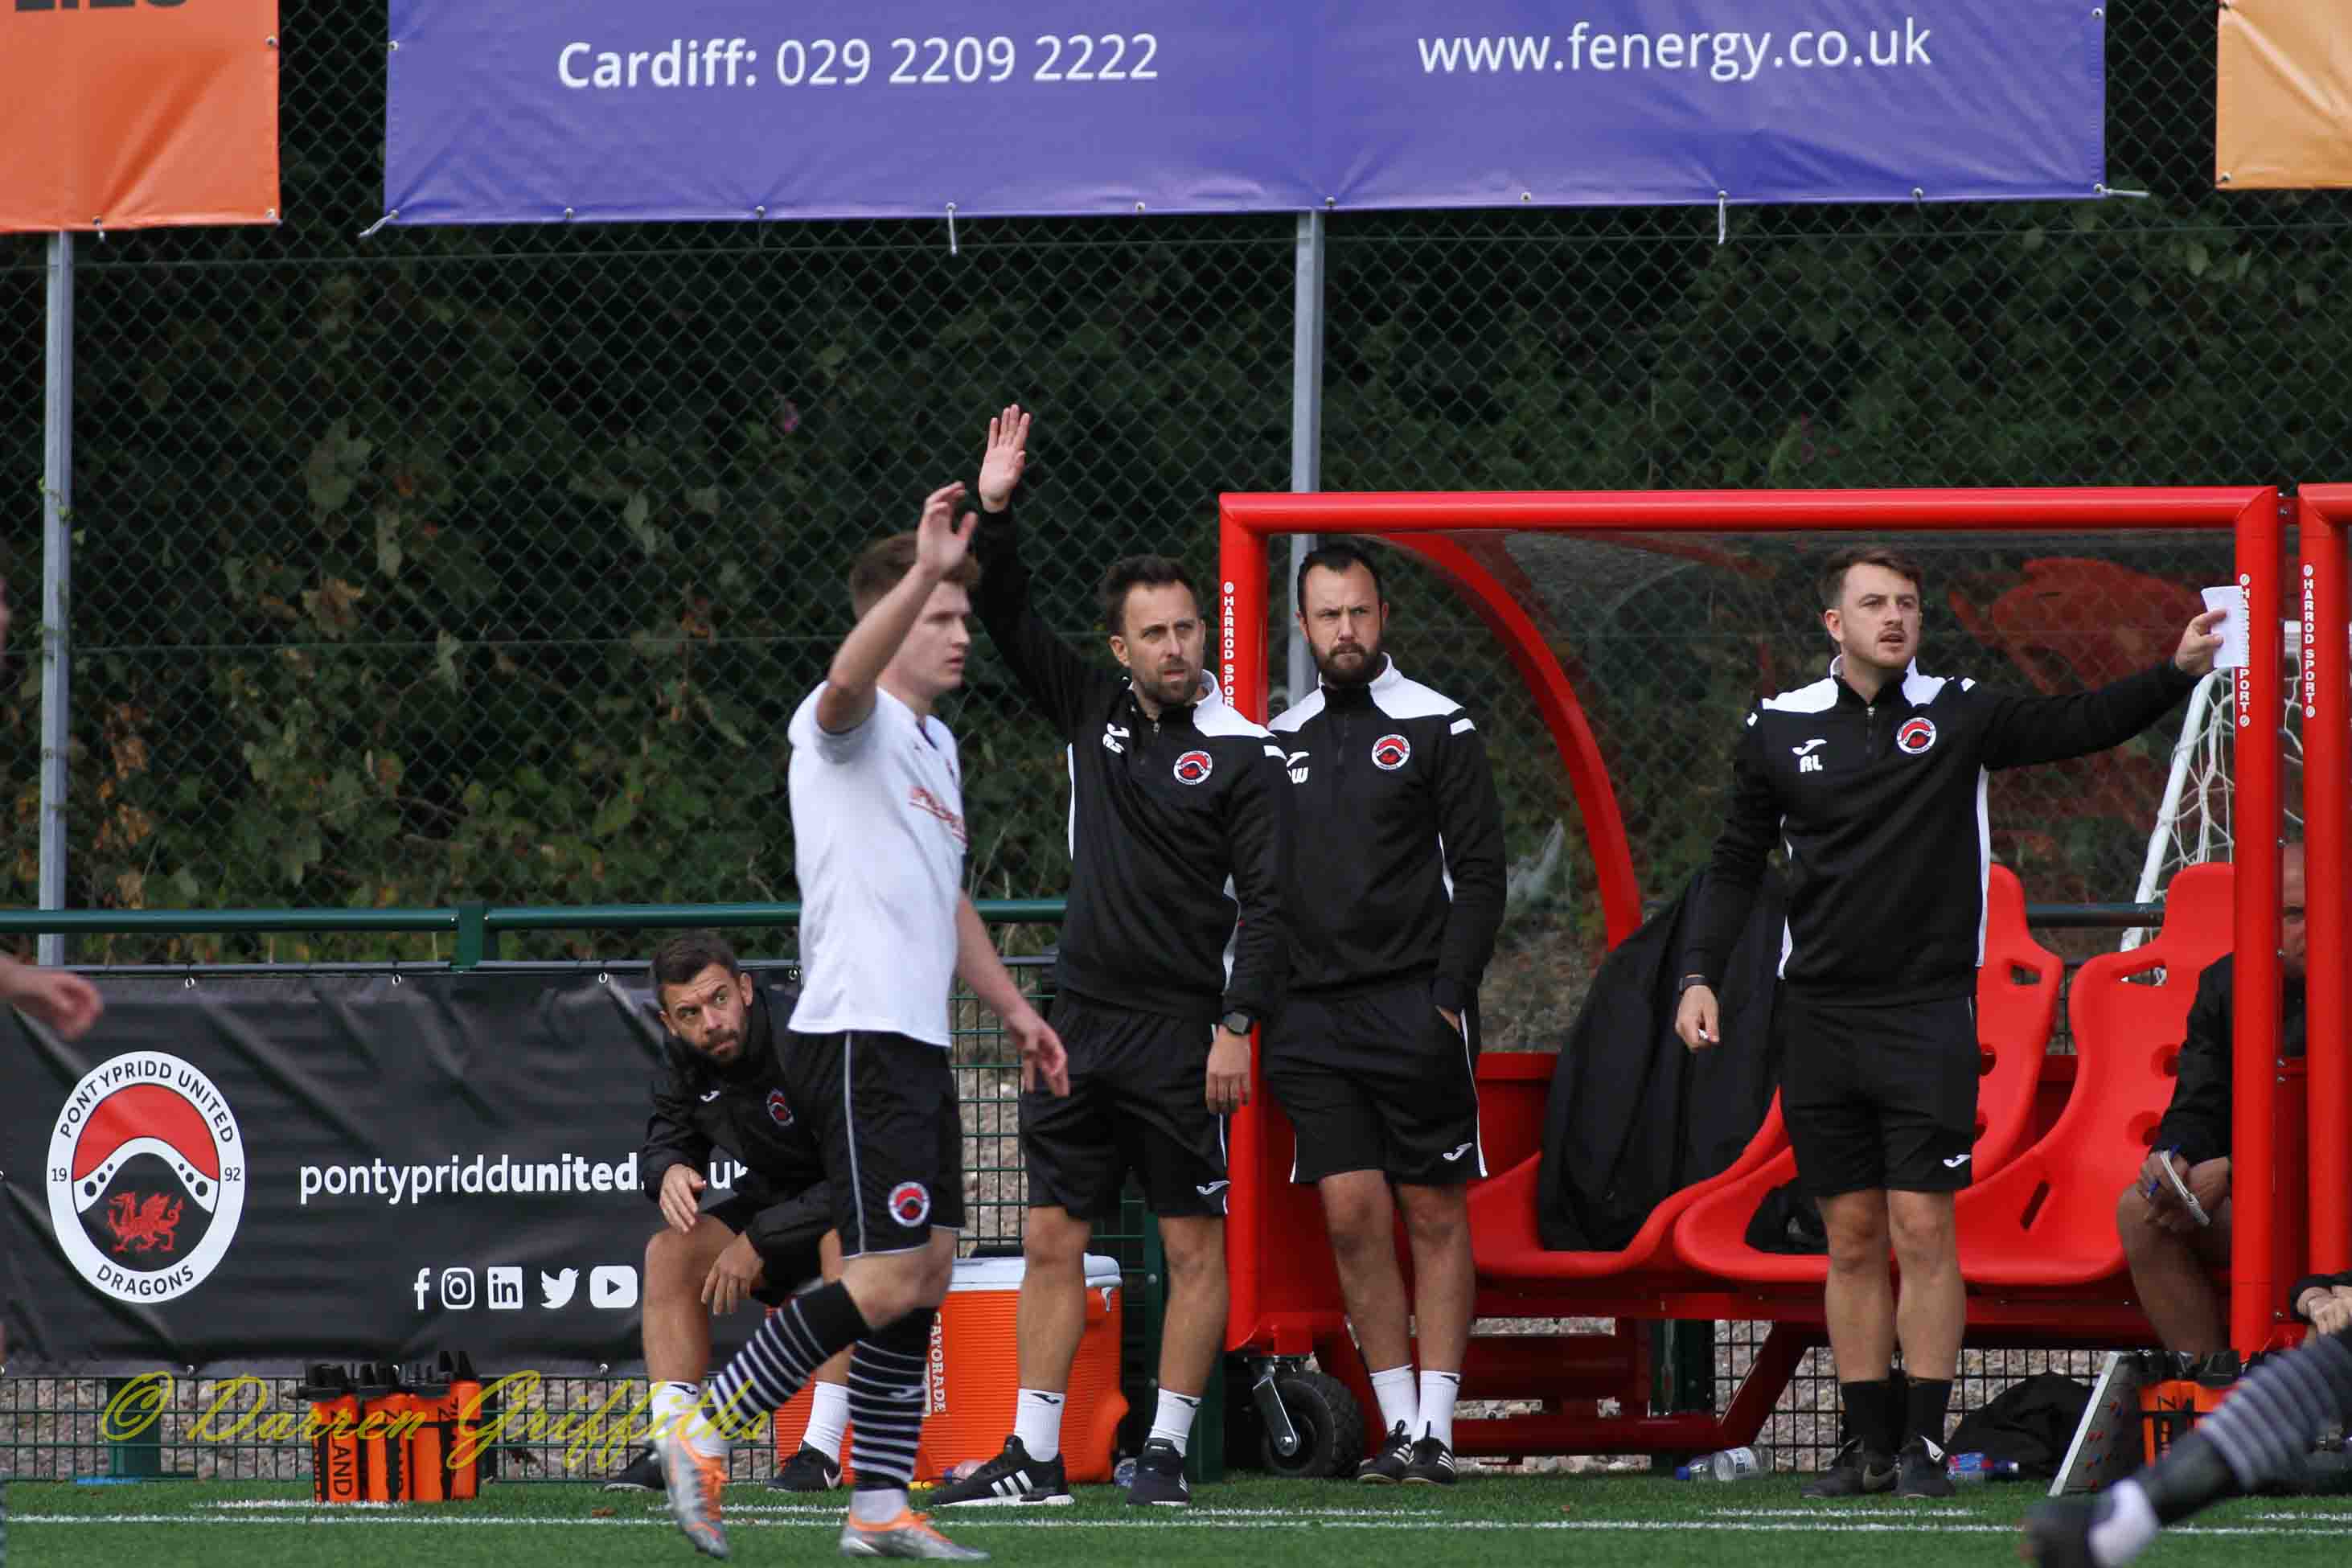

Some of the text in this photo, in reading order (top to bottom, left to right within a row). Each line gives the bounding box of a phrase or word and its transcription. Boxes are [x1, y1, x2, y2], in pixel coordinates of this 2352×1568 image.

[557, 33, 1159, 88] Cardiff: 029 2209 2222
[1418, 17, 1931, 82] www.fenergy.co.uk
[1224, 596, 1235, 707] HARROD SPOR
[2304, 578, 2316, 704] HARROD SPORT
[2239, 668, 2250, 712] PORT
[1800, 754, 1823, 773] RL
[60, 1060, 234, 1143] PONTYPRIDD UNITED
[51, 1168, 68, 1182] 19
[224, 1167, 240, 1182] 92
[96, 1263, 195, 1296] DRAGONS
